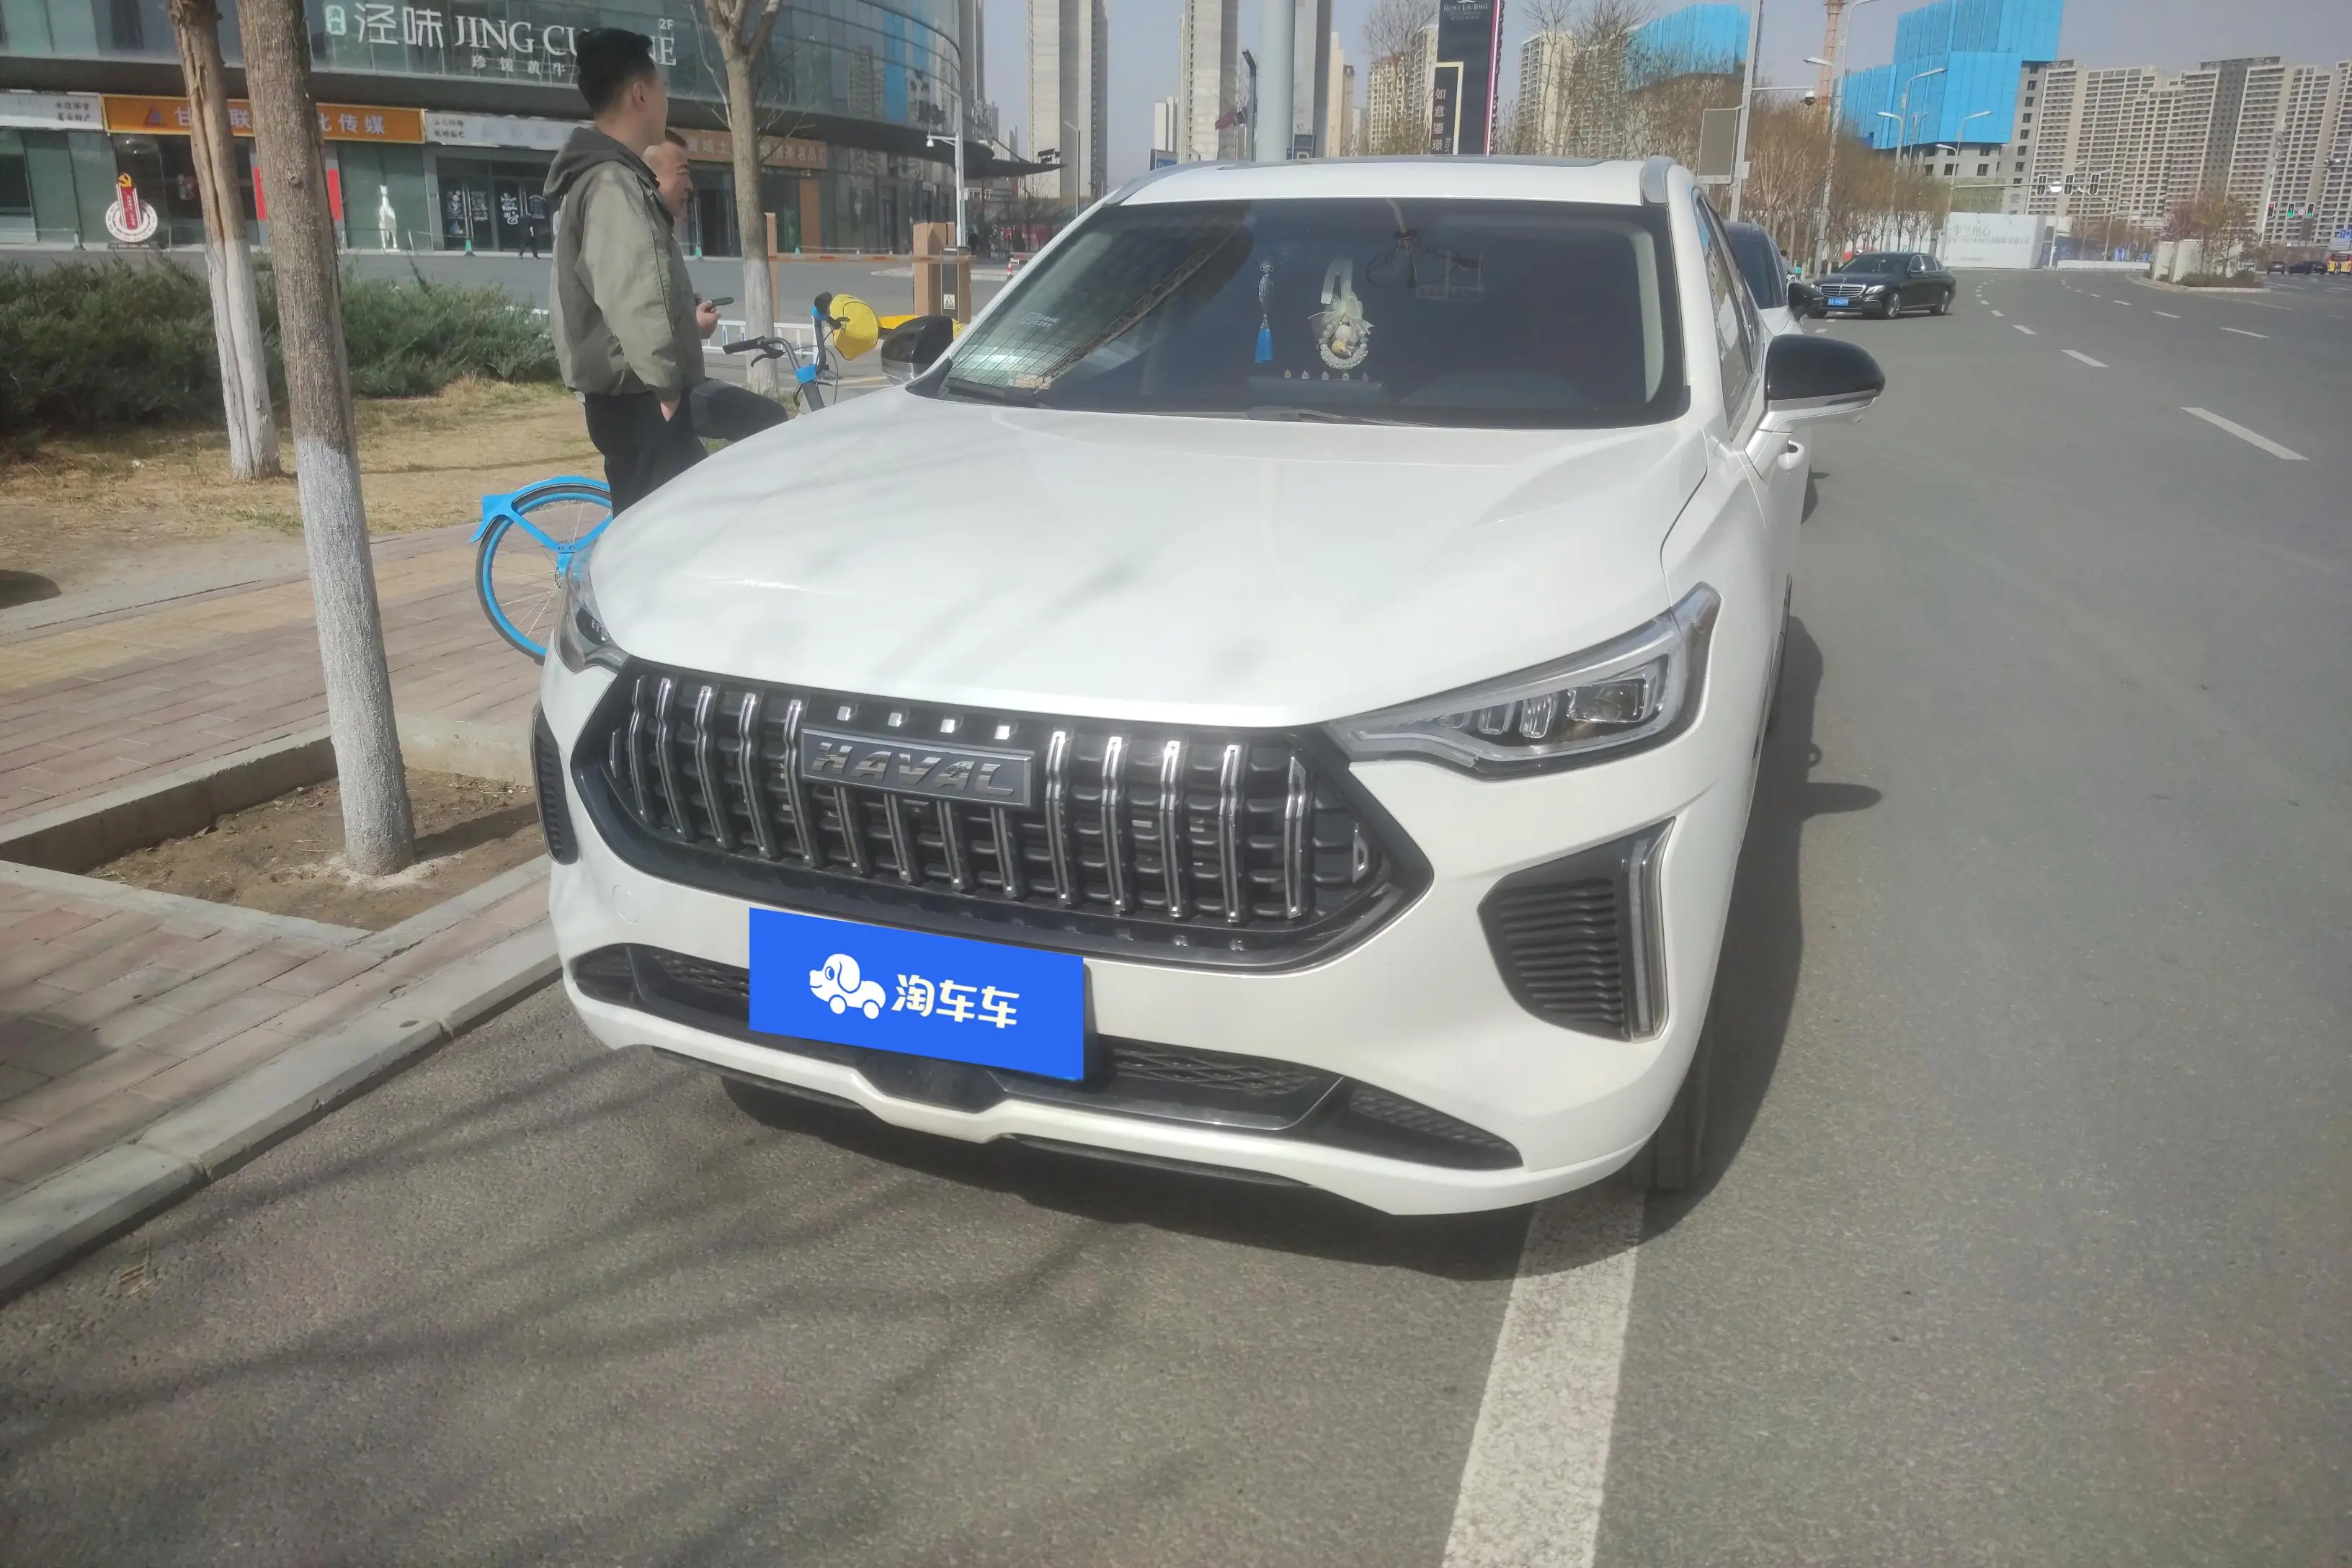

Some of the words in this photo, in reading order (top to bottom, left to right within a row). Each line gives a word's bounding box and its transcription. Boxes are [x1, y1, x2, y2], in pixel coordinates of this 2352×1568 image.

[354, 2, 443, 48] 泾味
[454, 15, 535, 53] JING
[658, 18, 674, 30] 2F
[811, 742, 1014, 796] HAVAL
